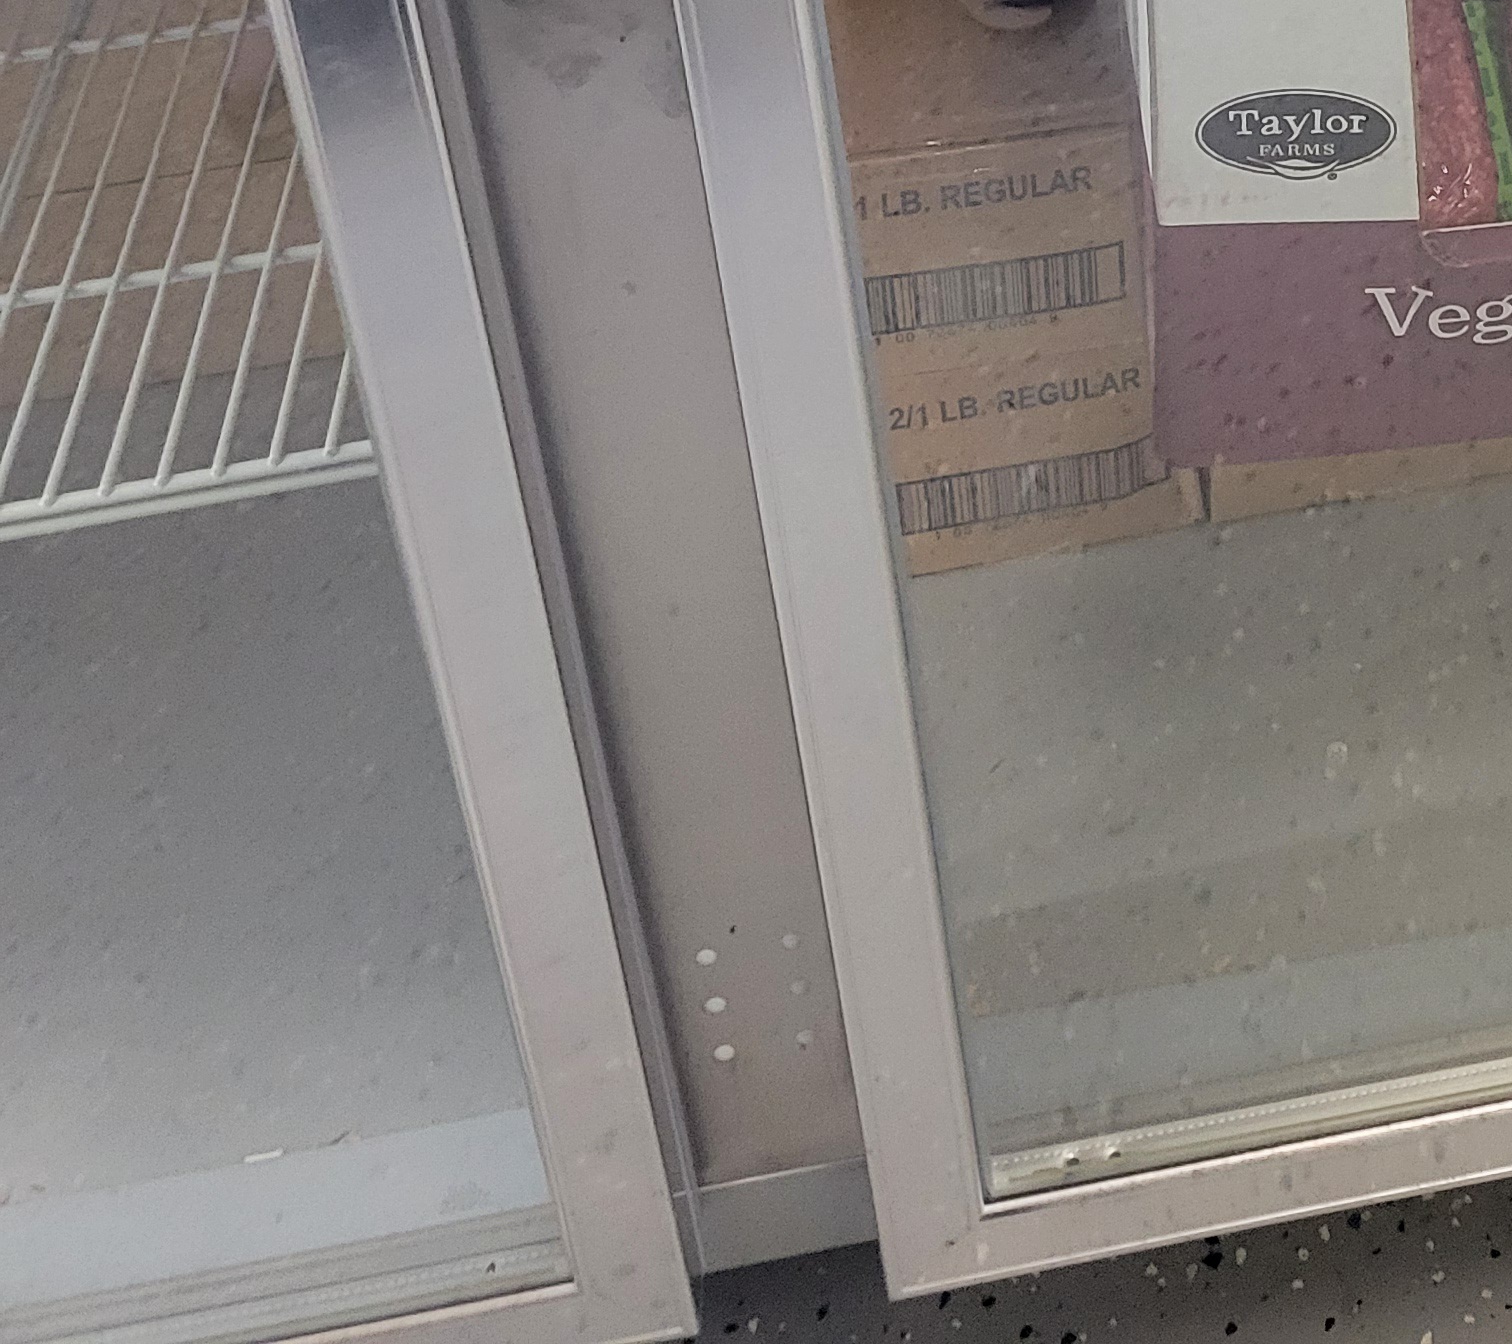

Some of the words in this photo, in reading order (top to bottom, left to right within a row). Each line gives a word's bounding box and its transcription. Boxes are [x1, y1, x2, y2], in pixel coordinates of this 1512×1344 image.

[1228, 109, 1368, 142] Taylor
[1259, 143, 1336, 157] FARMS
[881, 188, 931, 219] LB.
[940, 165, 1094, 212] REGULAR
[888, 403, 930, 430] 2/1
[996, 367, 1142, 414] REGULAR
